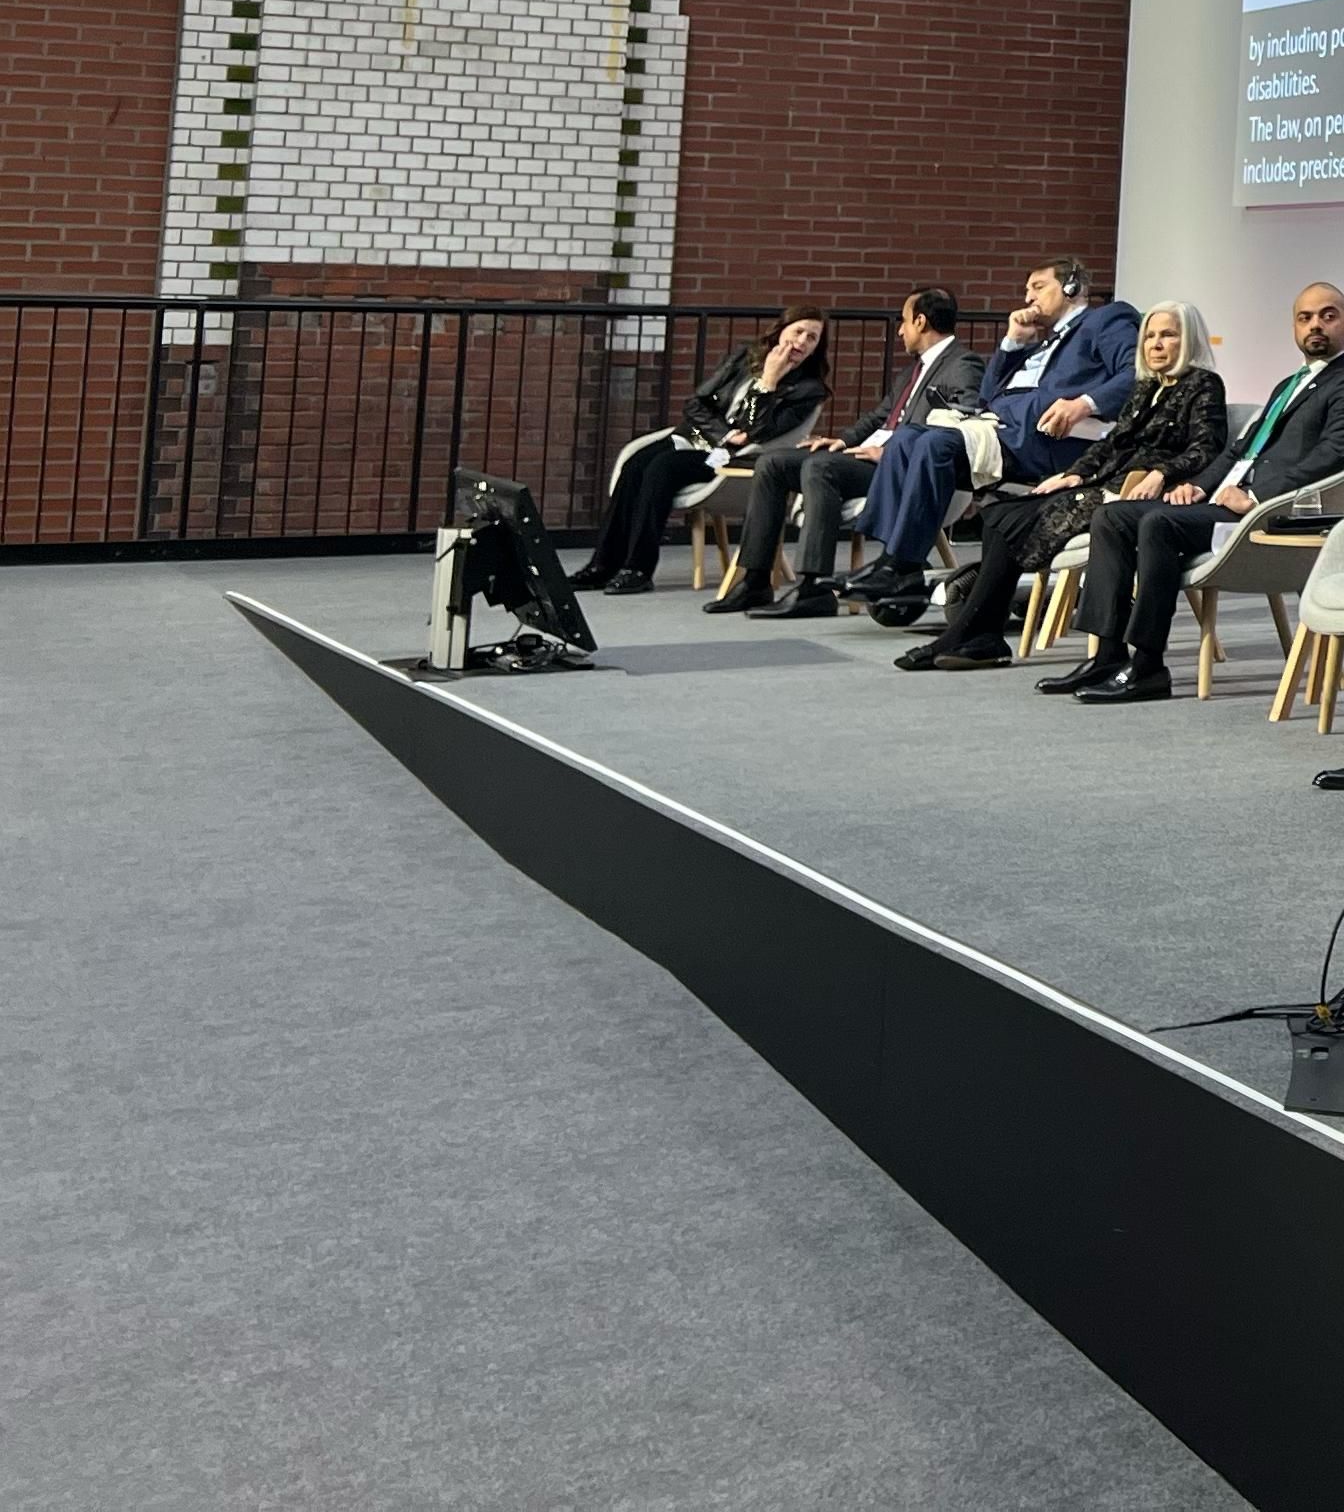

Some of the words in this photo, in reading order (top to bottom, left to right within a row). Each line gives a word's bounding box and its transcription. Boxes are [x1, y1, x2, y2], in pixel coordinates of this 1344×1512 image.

[1249, 36, 1264, 66] by
[1267, 26, 1327, 58] including
[1247, 69, 1320, 102] disabilities.
[1249, 114, 1273, 143] The
[1276, 114, 1302, 143] law,
[1304, 116, 1322, 138] on
[1243, 155, 1296, 184] includes
